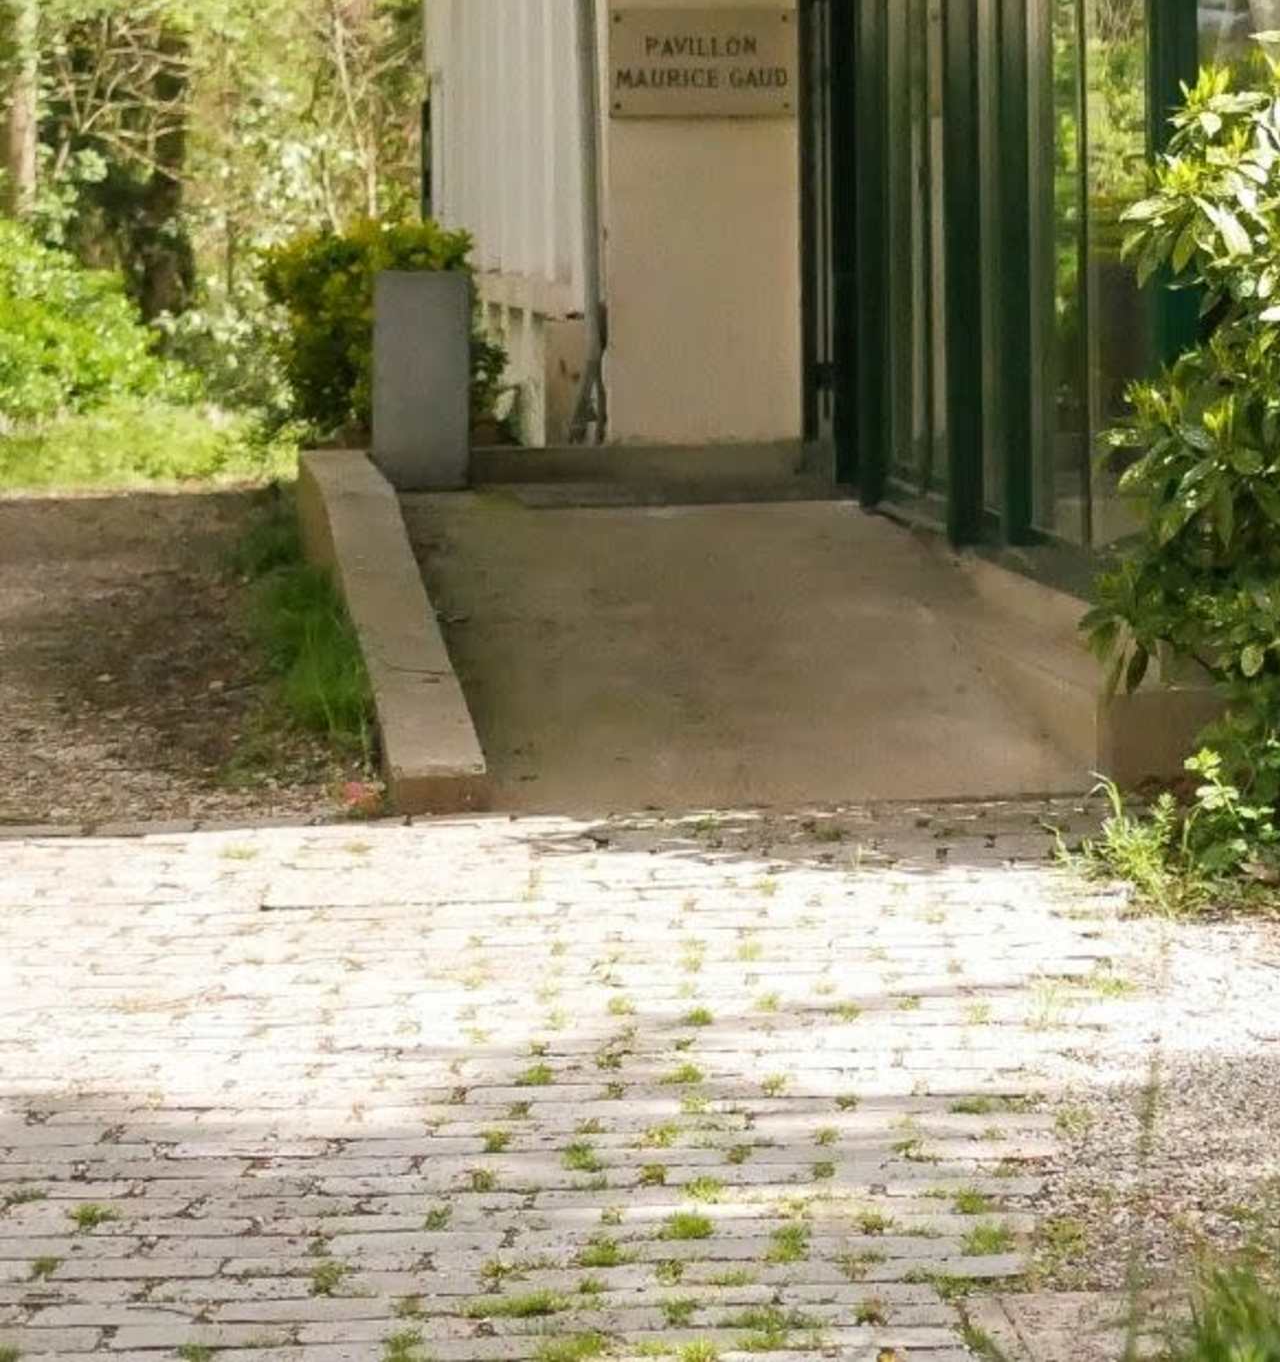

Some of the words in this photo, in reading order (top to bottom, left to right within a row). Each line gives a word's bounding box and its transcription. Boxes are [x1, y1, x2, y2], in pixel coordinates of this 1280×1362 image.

[645, 36, 758, 58] PAVILLON
[616, 68, 720, 89] MAURICE
[728, 68, 789, 88] GAUD
